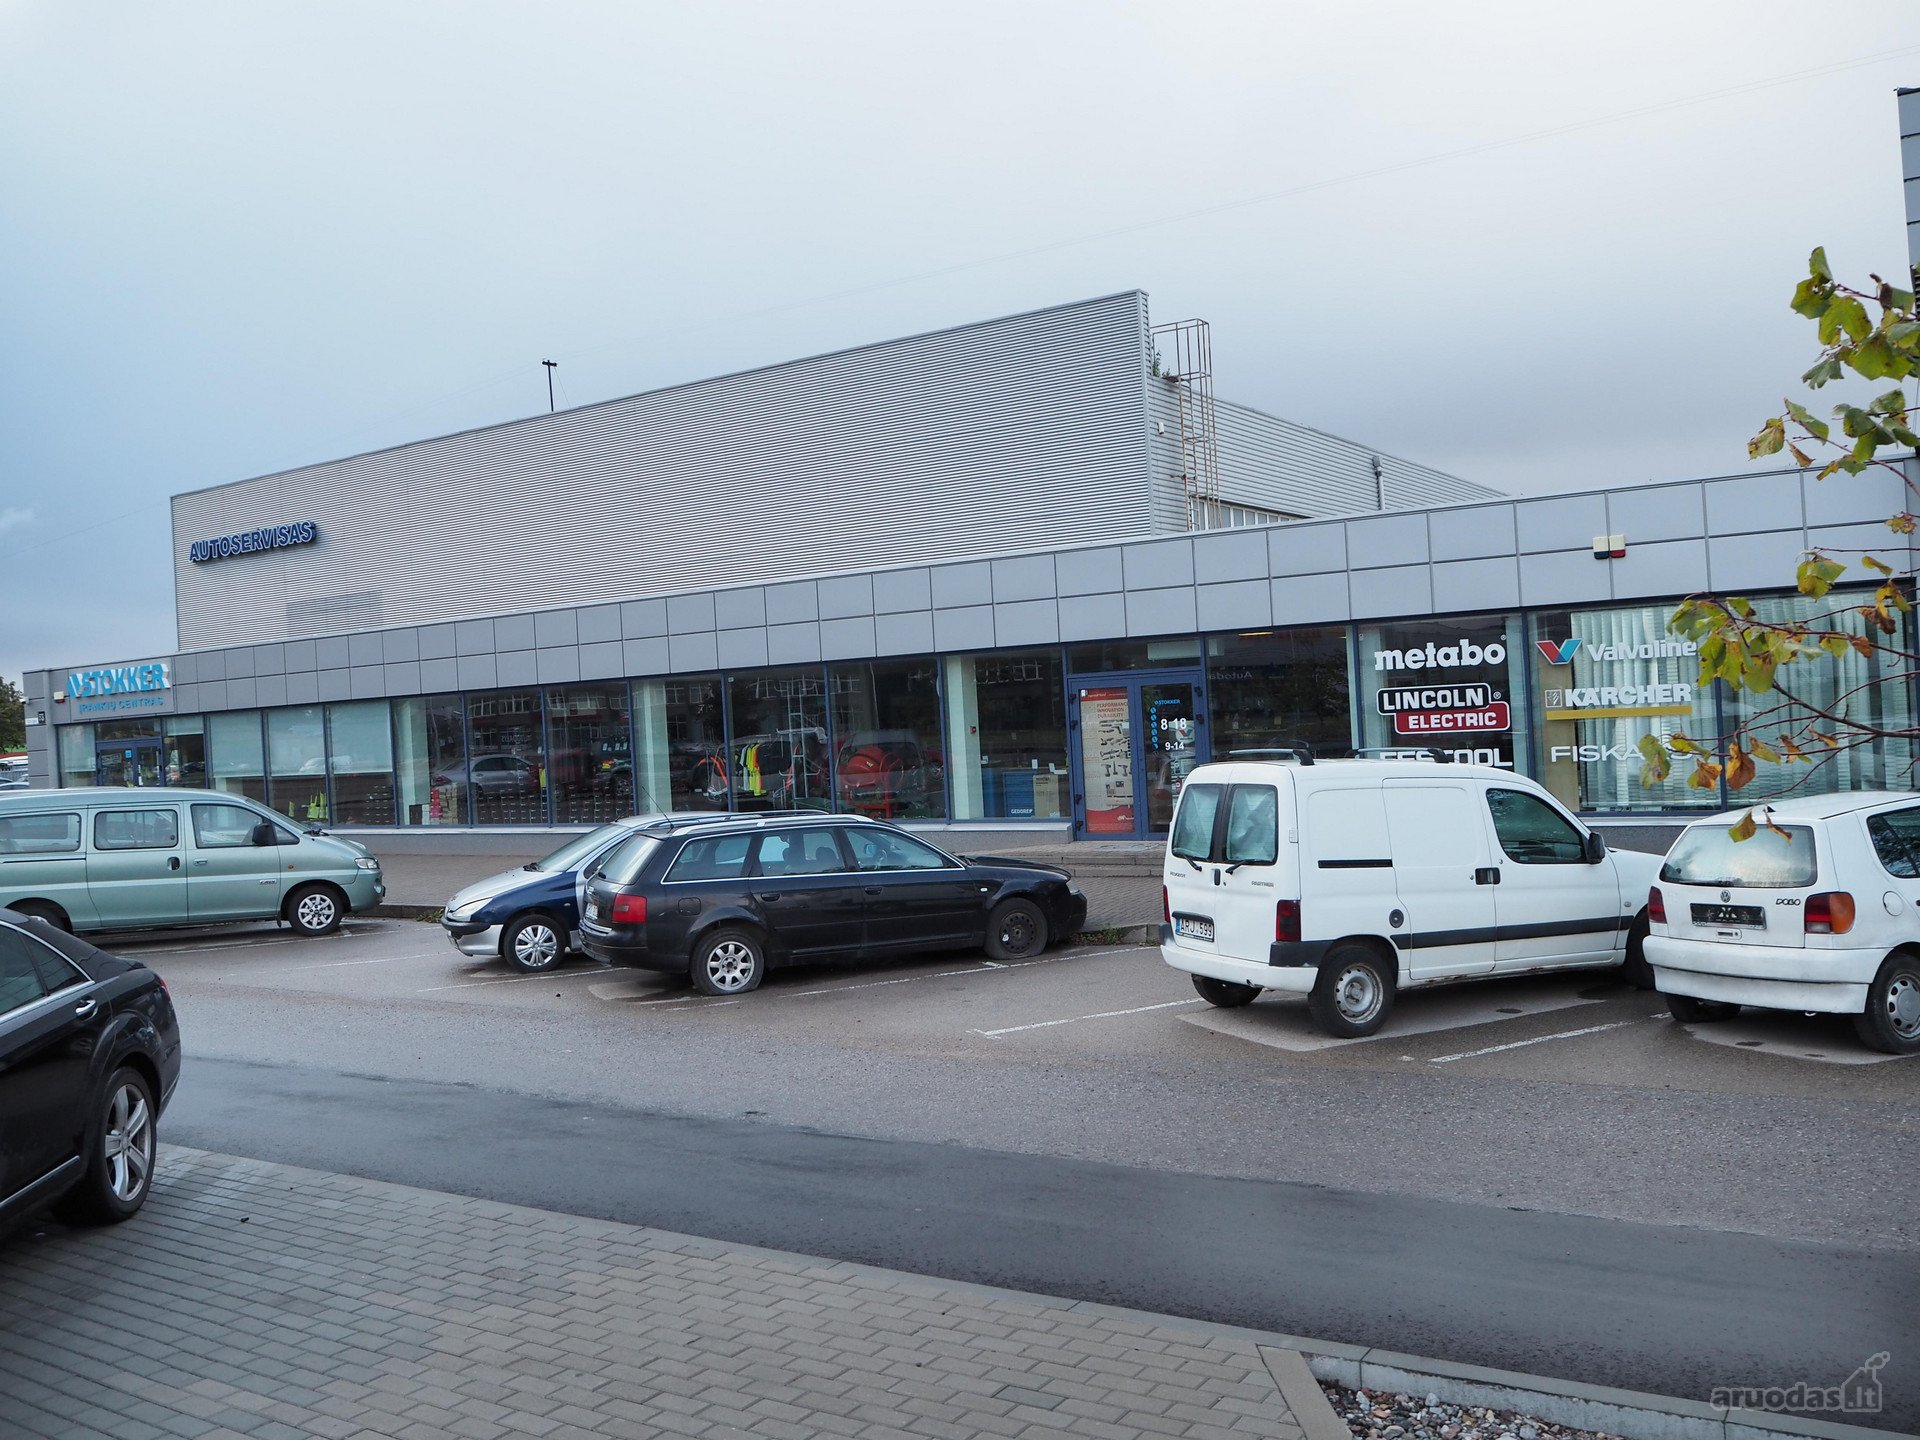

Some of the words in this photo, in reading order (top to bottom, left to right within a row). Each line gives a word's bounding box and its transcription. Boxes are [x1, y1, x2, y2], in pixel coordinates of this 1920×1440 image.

[190, 520, 317, 562] AUTOSERVISAS
[1374, 639, 1506, 670] metabo
[1587, 640, 1697, 661] Valvoline
[80, 663, 170, 697] STOKKER
[1383, 688, 1484, 710] LINCOLN
[1408, 712, 1497, 729] ELECTRIC
[1164, 742, 1185, 751] 9-14
[1551, 743, 1693, 763] FISKAS
[1380, 748, 1513, 767] FESOOL
[1776, 898, 1801, 906] POLO
[1181, 919, 1196, 933] ARJ
[1199, 922, 1213, 937] 599
